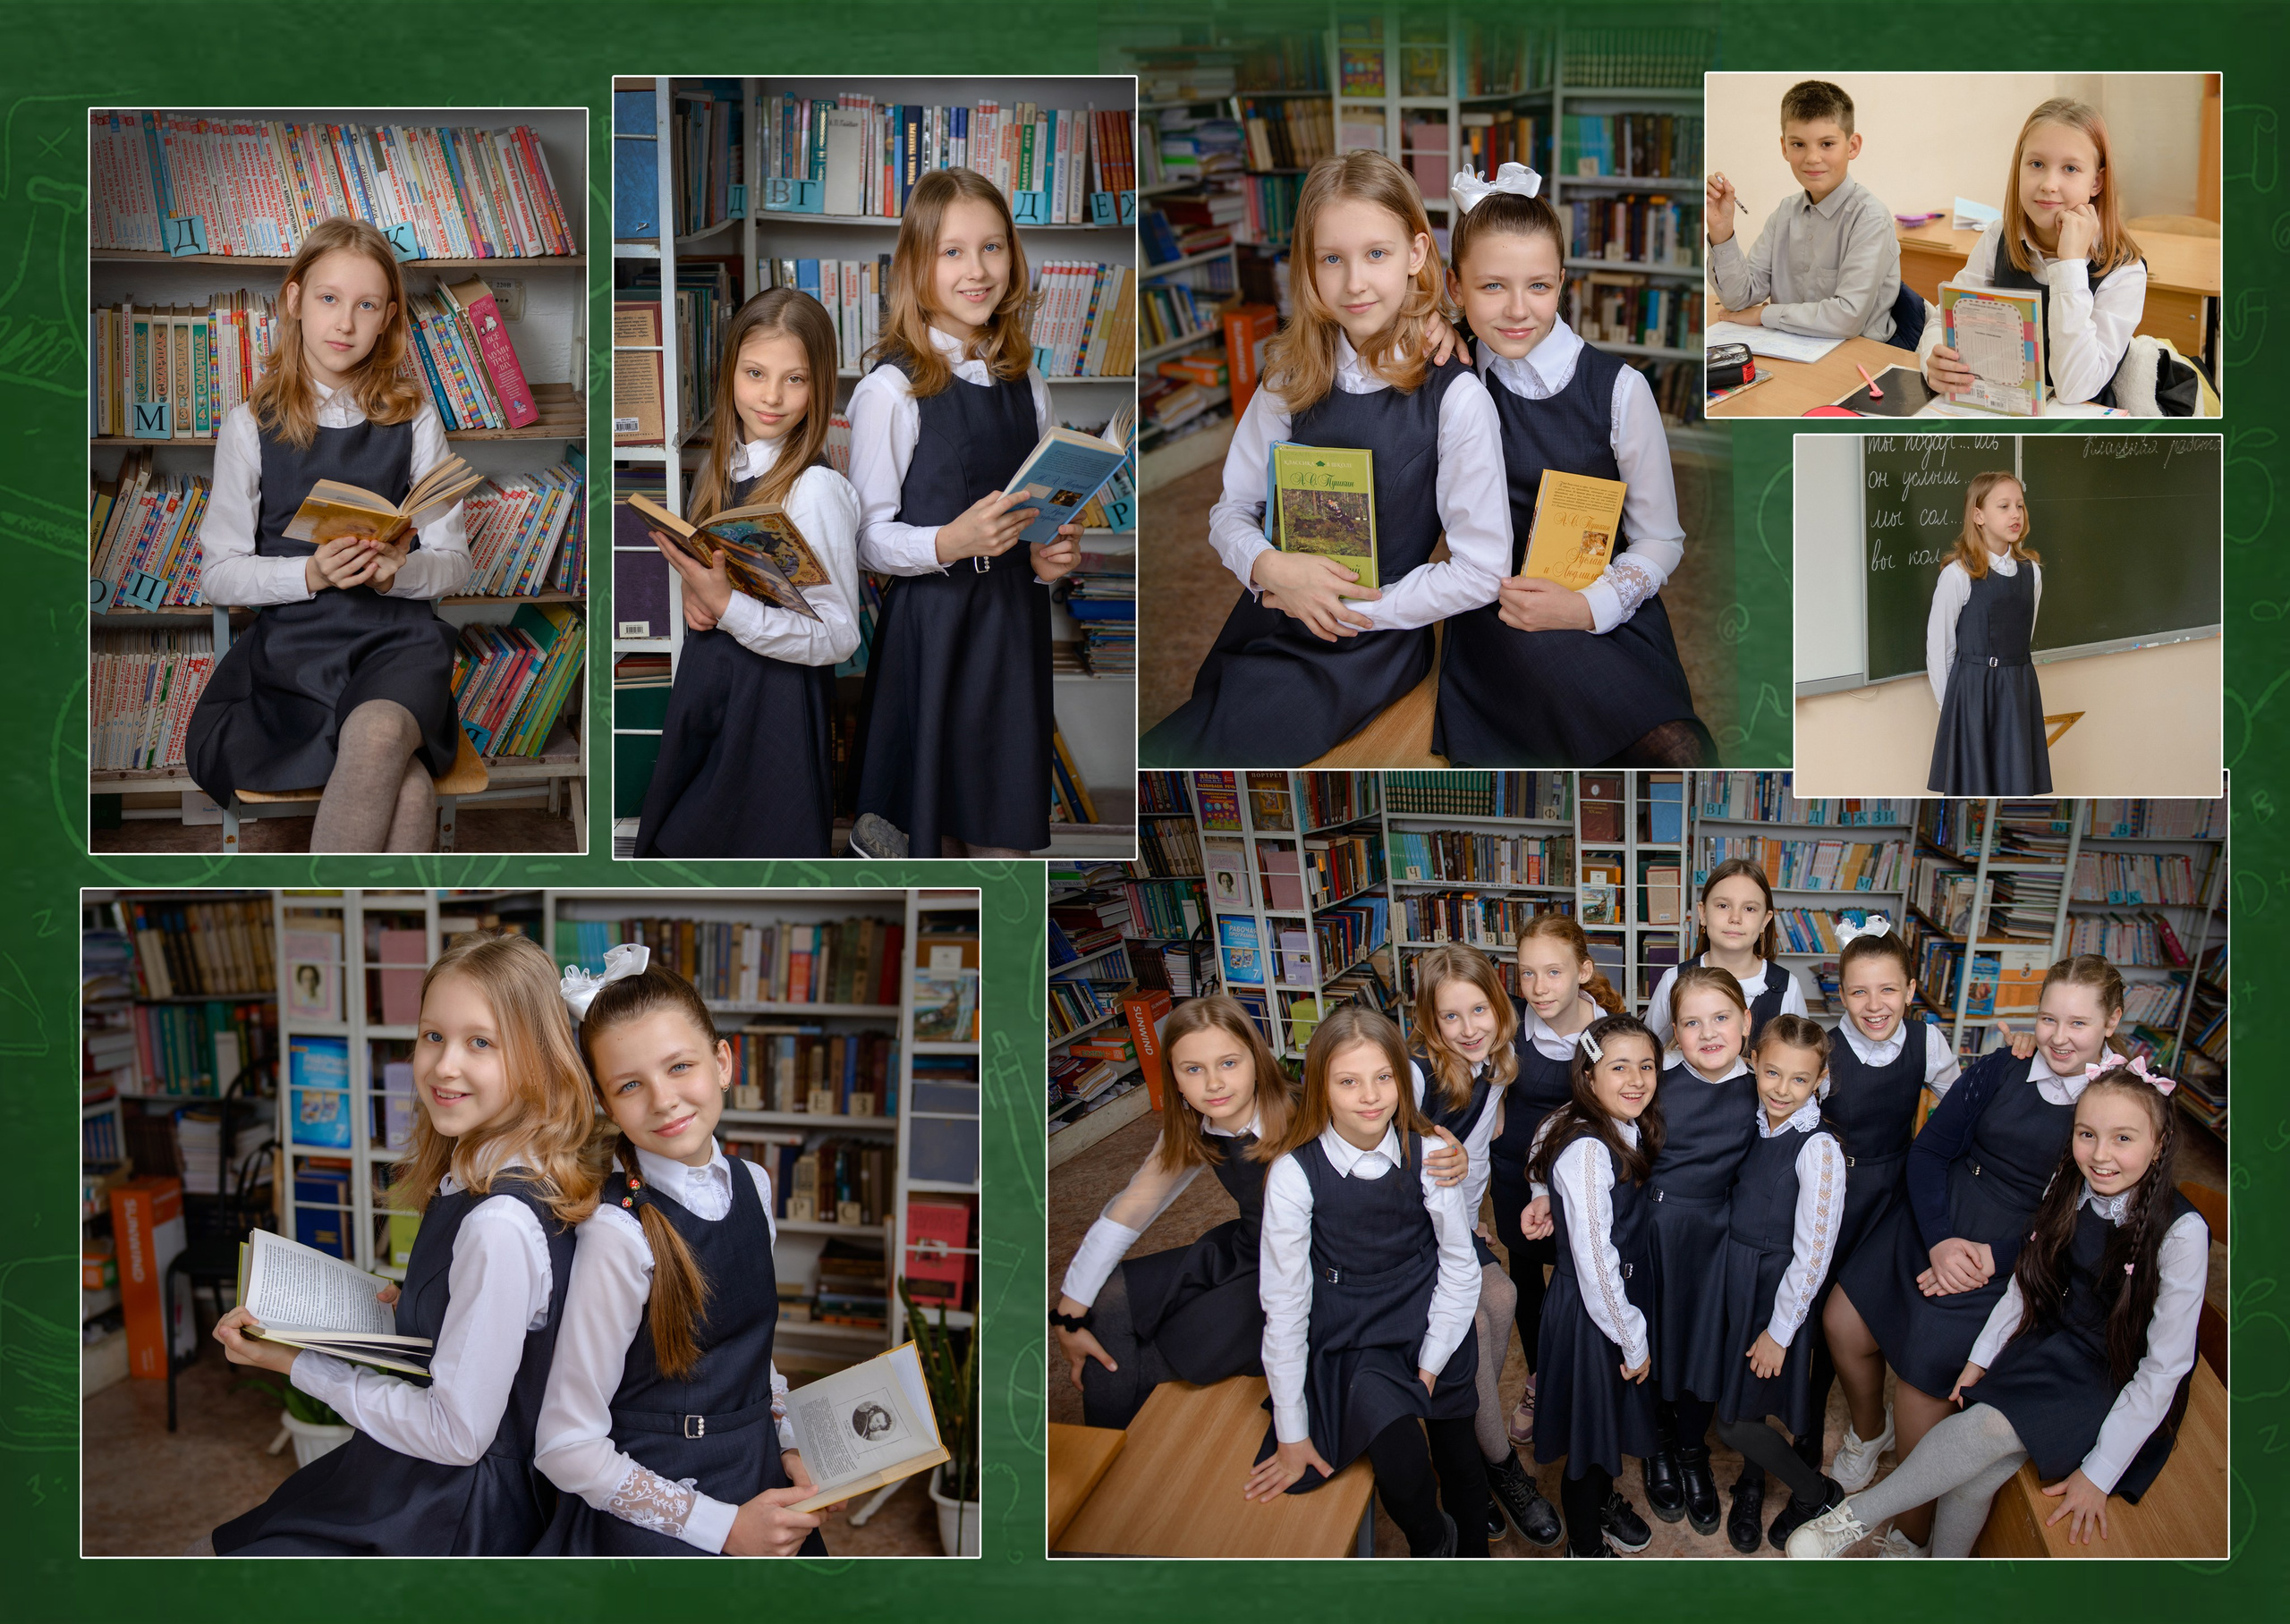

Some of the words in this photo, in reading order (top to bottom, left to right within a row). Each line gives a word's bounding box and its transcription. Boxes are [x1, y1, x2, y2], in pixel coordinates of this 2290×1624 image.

[95, 142, 103, 165] ЗЕРКАЛ
[108, 136, 120, 187] КРАСНОКОЖИХ
[226, 143, 236, 177] РАССКАЗЫ
[238, 141, 250, 176] РАССКАЗЫ
[266, 143, 276, 175] БУРАТИНО
[317, 150, 328, 176] Пуховой
[432, 133, 450, 179] Здравствуйте!
[384, 148, 398, 187] КУРОЛЕСОВА
[98, 168, 107, 196] КРИВЫХ
[324, 184, 333, 196] Дом
[329, 165, 343, 200] ЗОЩЕНКО
[360, 165, 374, 200] ЗОЩЕНКО
[446, 182, 455, 199] Трям!
[475, 178, 484, 196] Трям!
[772, 180, 790, 203] В
[115, 190, 123, 214] ВОЖДЬ
[234, 179, 246, 219] ДЕНИСКИНЫ
[247, 178, 259, 217] ДЕНИСКИНЫ
[275, 179, 289, 224] ПРИКЛЮЧЕНИЯ
[394, 189, 403, 205] ВАСИ
[532, 192, 540, 214] МАТРОС
[798, 182, 817, 206] Г
[1094, 193, 1111, 218] Е
[371, 201, 379, 219] МИХ.
[428, 190, 441, 224] КРЫЛОВА
[493, 190, 506, 224] КРЫЛОВА
[552, 189, 566, 223] КРЫЛОВА
[1014, 192, 1039, 223] Д
[104, 199, 114, 243] КОРОЛЕВСТВО
[174, 218, 200, 256] Д
[438, 229, 450, 253] БАСНИ
[504, 229, 514, 252] БАСНИ
[539, 219, 553, 250] КУРОЛЕСОВ
[563, 226, 575, 250] БАСНИ
[135, 331, 148, 393] С.МАРШАК
[154, 332, 167, 395] С.МАРШАК
[424, 358, 438, 385] Мишкина
[133, 405, 167, 431] М
[180, 408, 188, 420] 3
[198, 408, 206, 420] 4
[1869, 436, 1896, 454] ты
[1318, 473, 1354, 490] Пушкин
[1868, 470, 1889, 488] он
[1111, 502, 1128, 526] Р
[1580, 515, 1611, 533] Пушкин
[1870, 509, 1904, 529] мы
[122, 526, 137, 554] ТОЛСТЯКА
[1566, 546, 1603, 568] Руслан
[1871, 539, 1896, 571] вы
[129, 571, 162, 604] П
[1544, 808, 1556, 819] Ф
[1707, 805, 1716, 814] В
[1717, 803, 1724, 815] Г
[1810, 812, 1819, 823] Д
[1844, 813, 1850, 824] Е
[1854, 812, 1867, 824] Ж
[1874, 810, 1882, 822] З
[1884, 810, 1894, 822] И
[2118, 825, 2127, 835] В
[1409, 867, 1418, 877] Ч
[1696, 871, 1705, 882] К
[1808, 877, 1818, 887] Л
[1857, 877, 1870, 889] М
[1318, 892, 1326, 907] Д
[2112, 892, 2118, 901] З
[2129, 892, 2139, 901] К
[1438, 930, 1445, 940] Б
[1486, 934, 1493, 943] В
[1505, 934, 1512, 942] Г
[1253, 969, 1259, 978] 7
[1132, 1005, 1154, 1055] SUNWIND
[123, 1198, 145, 1282] SUNWIND
